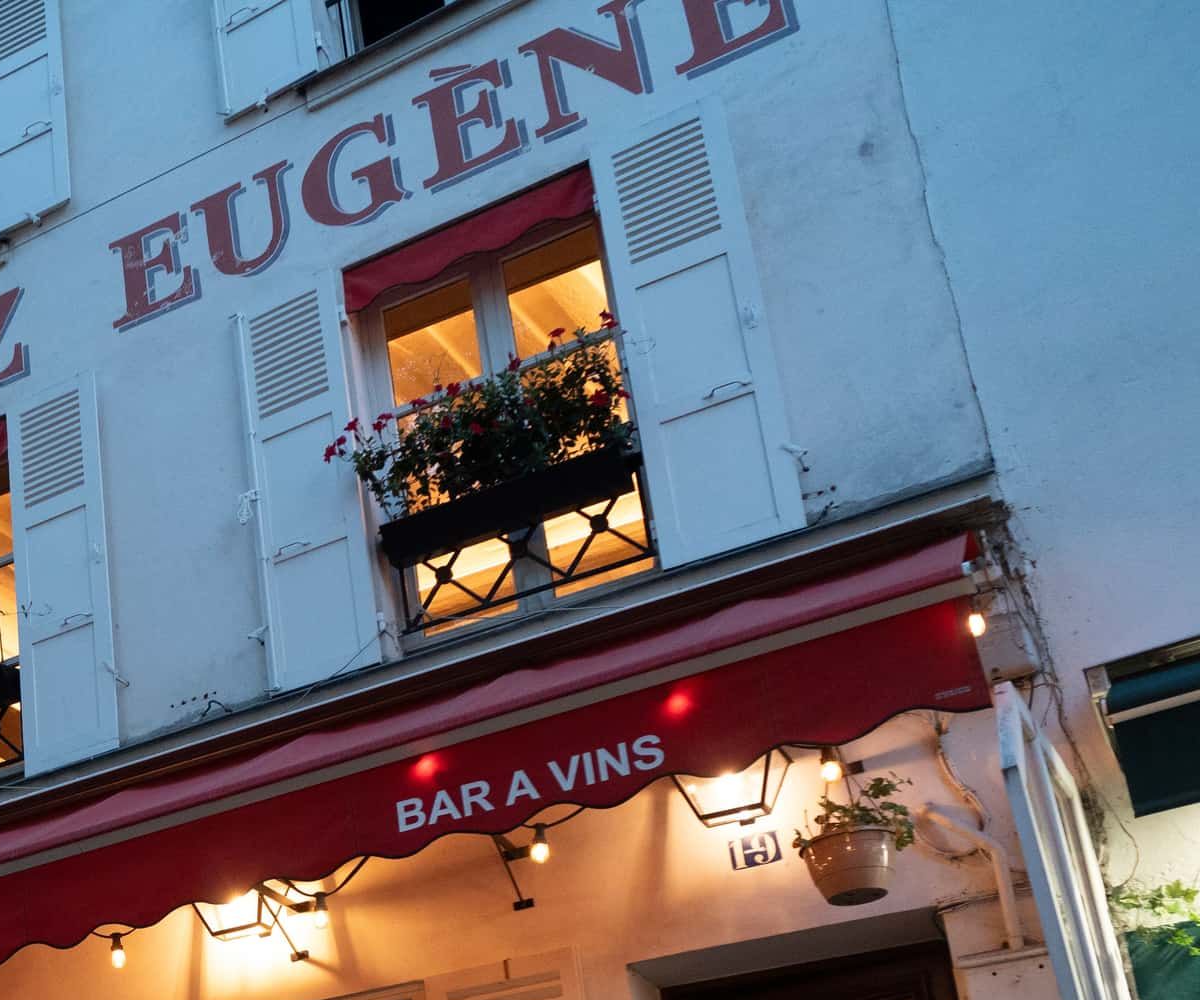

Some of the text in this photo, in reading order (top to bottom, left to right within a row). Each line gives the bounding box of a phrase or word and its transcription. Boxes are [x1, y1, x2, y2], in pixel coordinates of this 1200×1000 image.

[395, 733, 666, 834] BAR A VINS
[729, 833, 777, 870] 19
